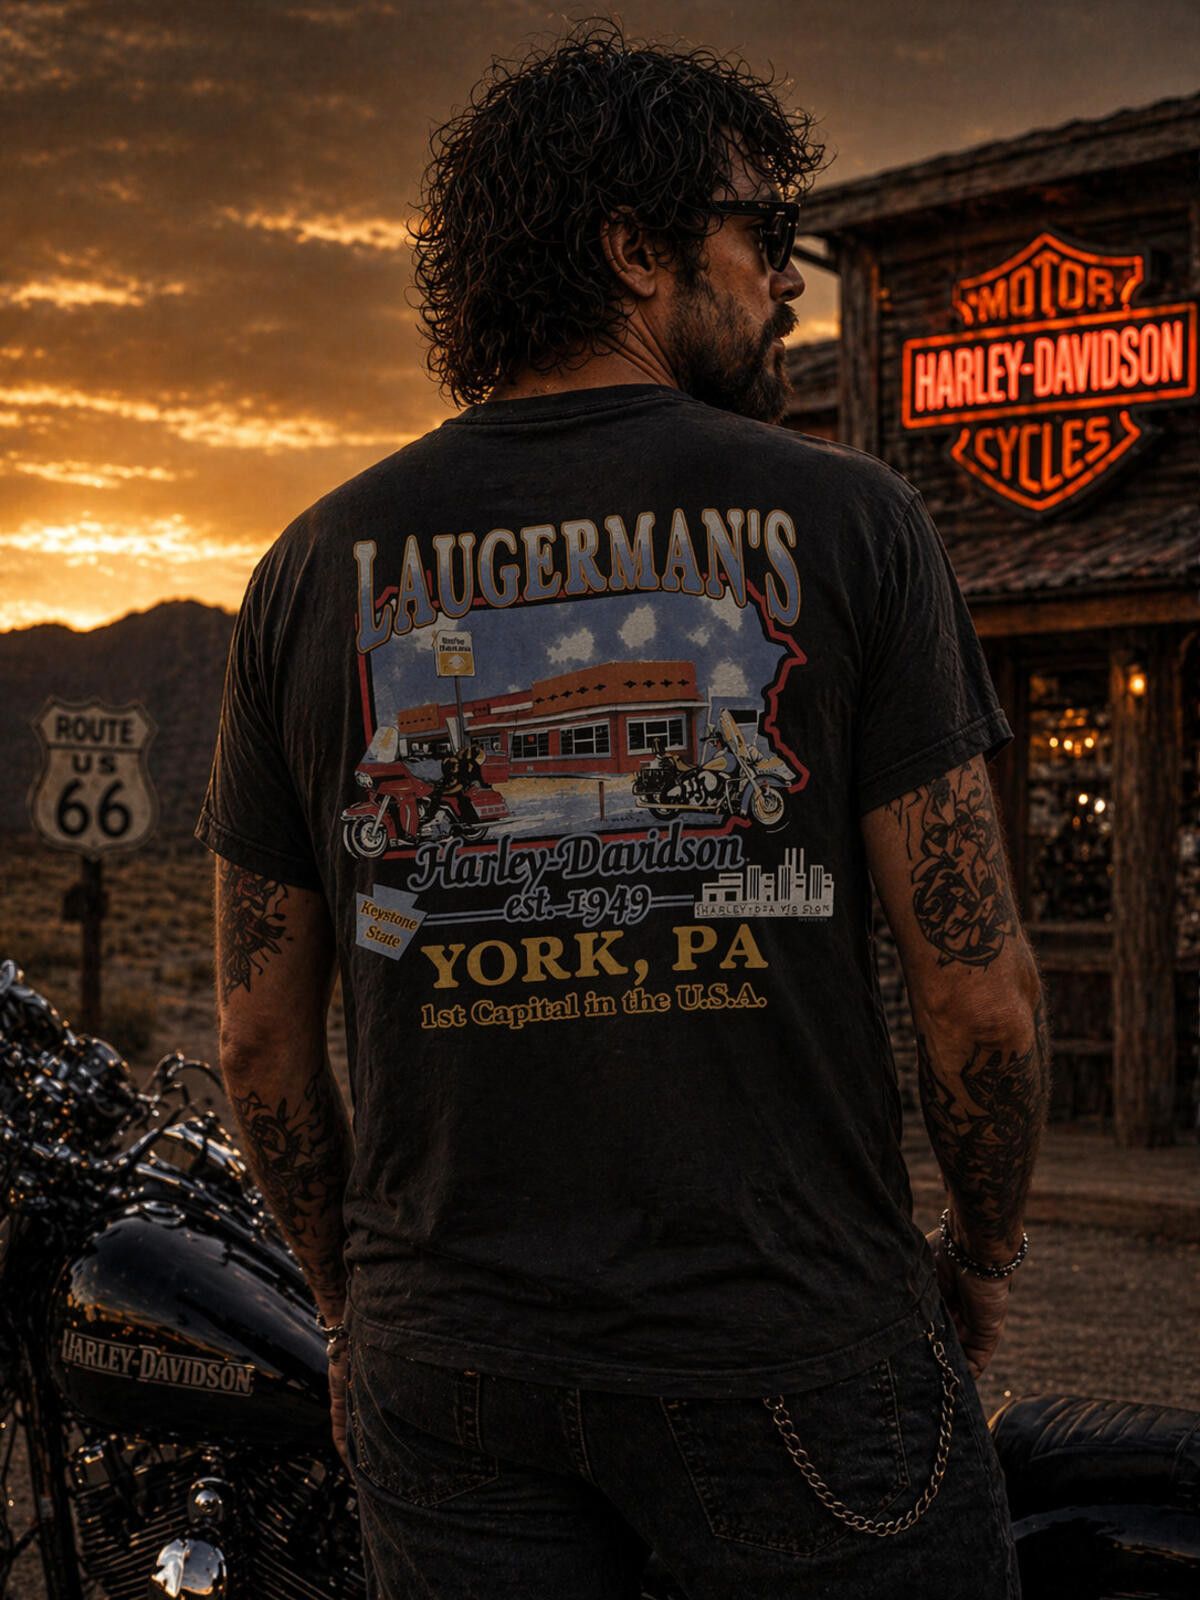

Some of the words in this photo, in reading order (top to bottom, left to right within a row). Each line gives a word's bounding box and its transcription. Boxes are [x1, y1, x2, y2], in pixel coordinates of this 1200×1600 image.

[969, 251, 1115, 323] MOTOR
[914, 319, 1184, 412] HARLEY-DAVIDSON
[974, 415, 1111, 494] CYCLES
[353, 507, 801, 654] LAUGERMAN'S
[56, 715, 135, 744] ROUTE
[57, 778, 131, 838] 66
[407, 820, 744, 895] Harley-Davidson
[360, 899, 418, 931] Keystone
[365, 925, 401, 948] State
[566, 884, 651, 928] 1949
[419, 929, 650, 987] YORK,
[671, 922, 770, 972] PA
[421, 1003, 467, 1030] 1st
[471, 992, 581, 1030] Capital
[585, 991, 617, 1017] in
[621, 987, 672, 1014] the
[676, 982, 768, 1011] U.S.A.
[61, 1329, 253, 1394] HARLEY-DAVIDSON
